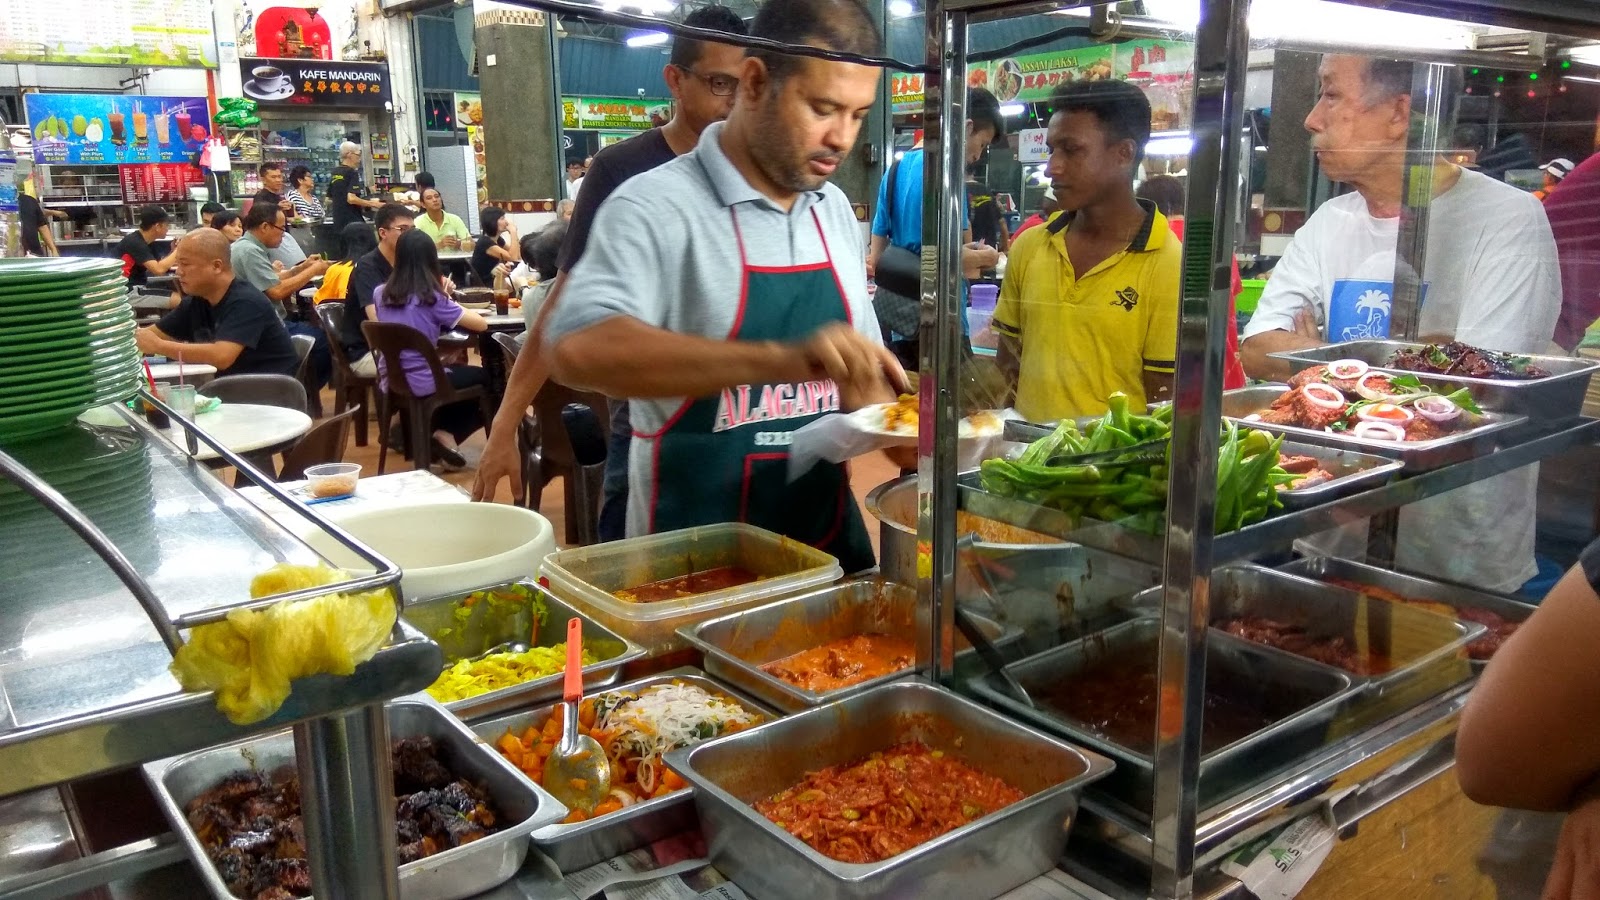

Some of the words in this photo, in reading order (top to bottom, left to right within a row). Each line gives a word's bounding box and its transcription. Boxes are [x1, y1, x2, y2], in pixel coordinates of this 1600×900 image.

[1022, 60, 1049, 72] ASSAM
[1050, 56, 1079, 70] LAKSA
[300, 70, 327, 80] KAFE
[329, 71, 381, 81] MANDARIN
